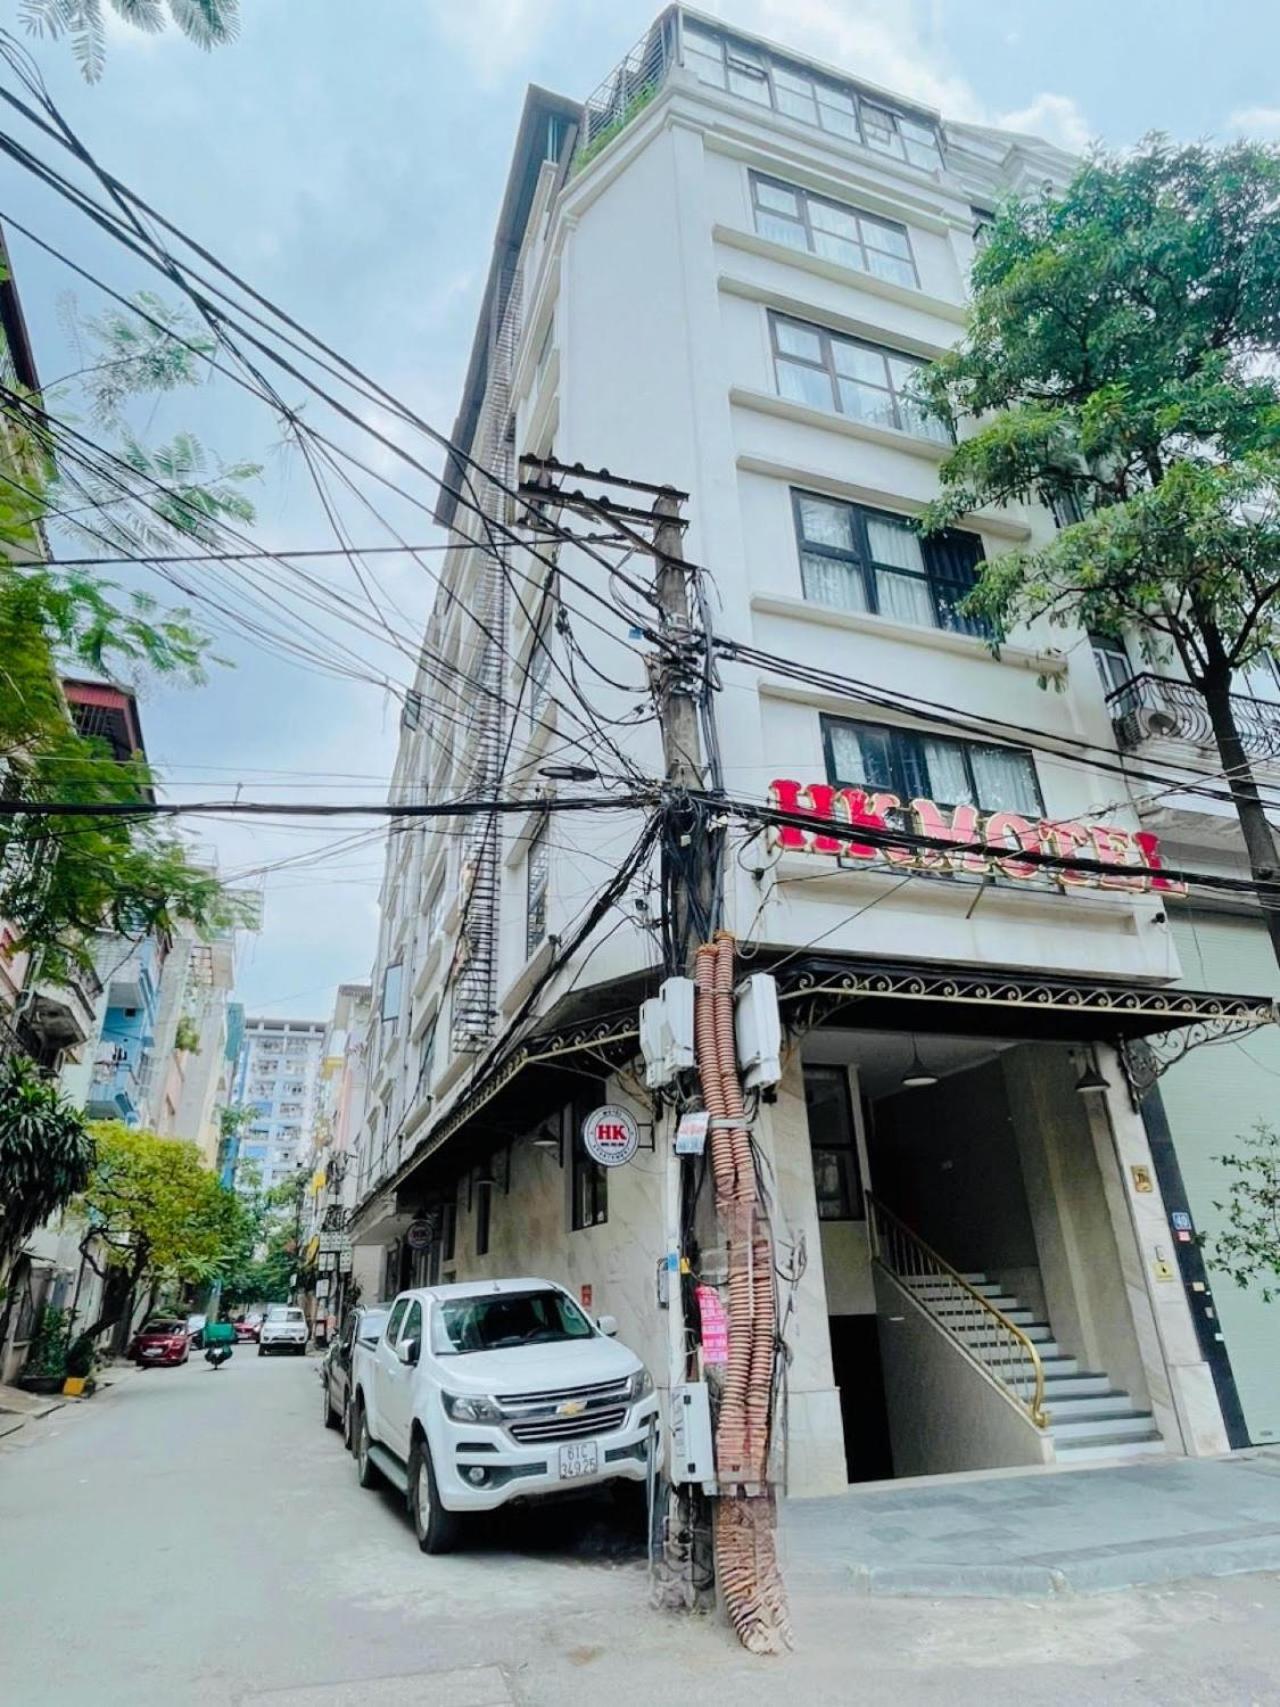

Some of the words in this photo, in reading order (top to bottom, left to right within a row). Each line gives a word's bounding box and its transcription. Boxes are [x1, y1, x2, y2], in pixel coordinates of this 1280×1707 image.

[770, 778, 917, 868] HK
[911, 798, 1189, 898] MOTEL
[598, 1124, 628, 1140] HK
